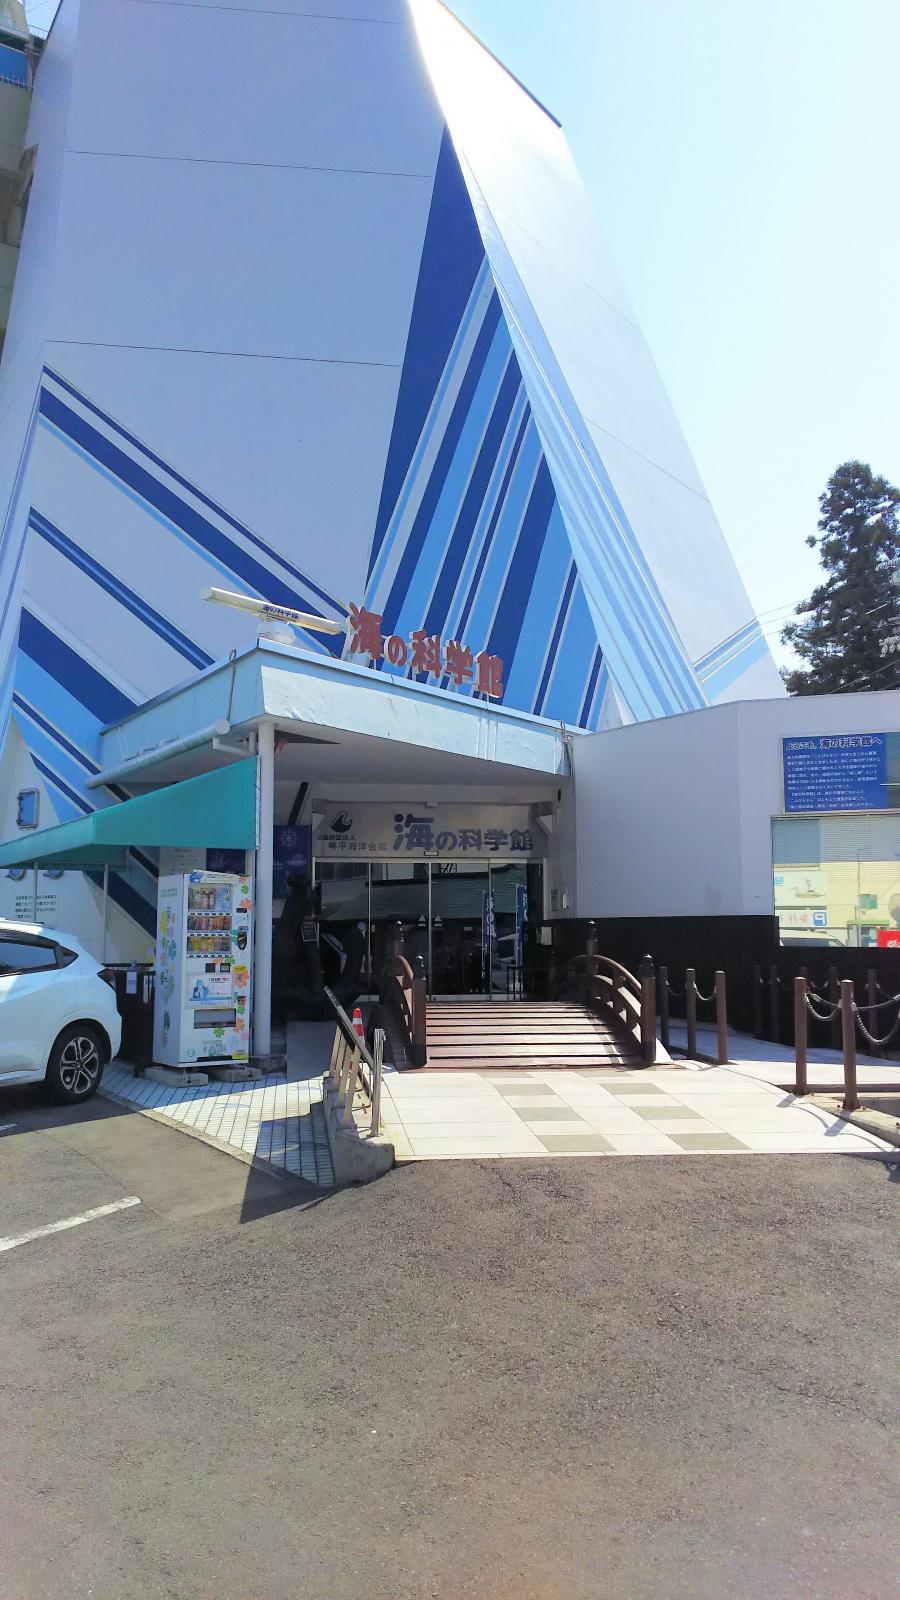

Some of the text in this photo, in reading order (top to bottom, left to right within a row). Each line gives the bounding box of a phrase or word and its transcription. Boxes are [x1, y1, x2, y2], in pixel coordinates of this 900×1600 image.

[350, 601, 504, 698] 海の科学館
[393, 813, 533, 851] 海の科学館
